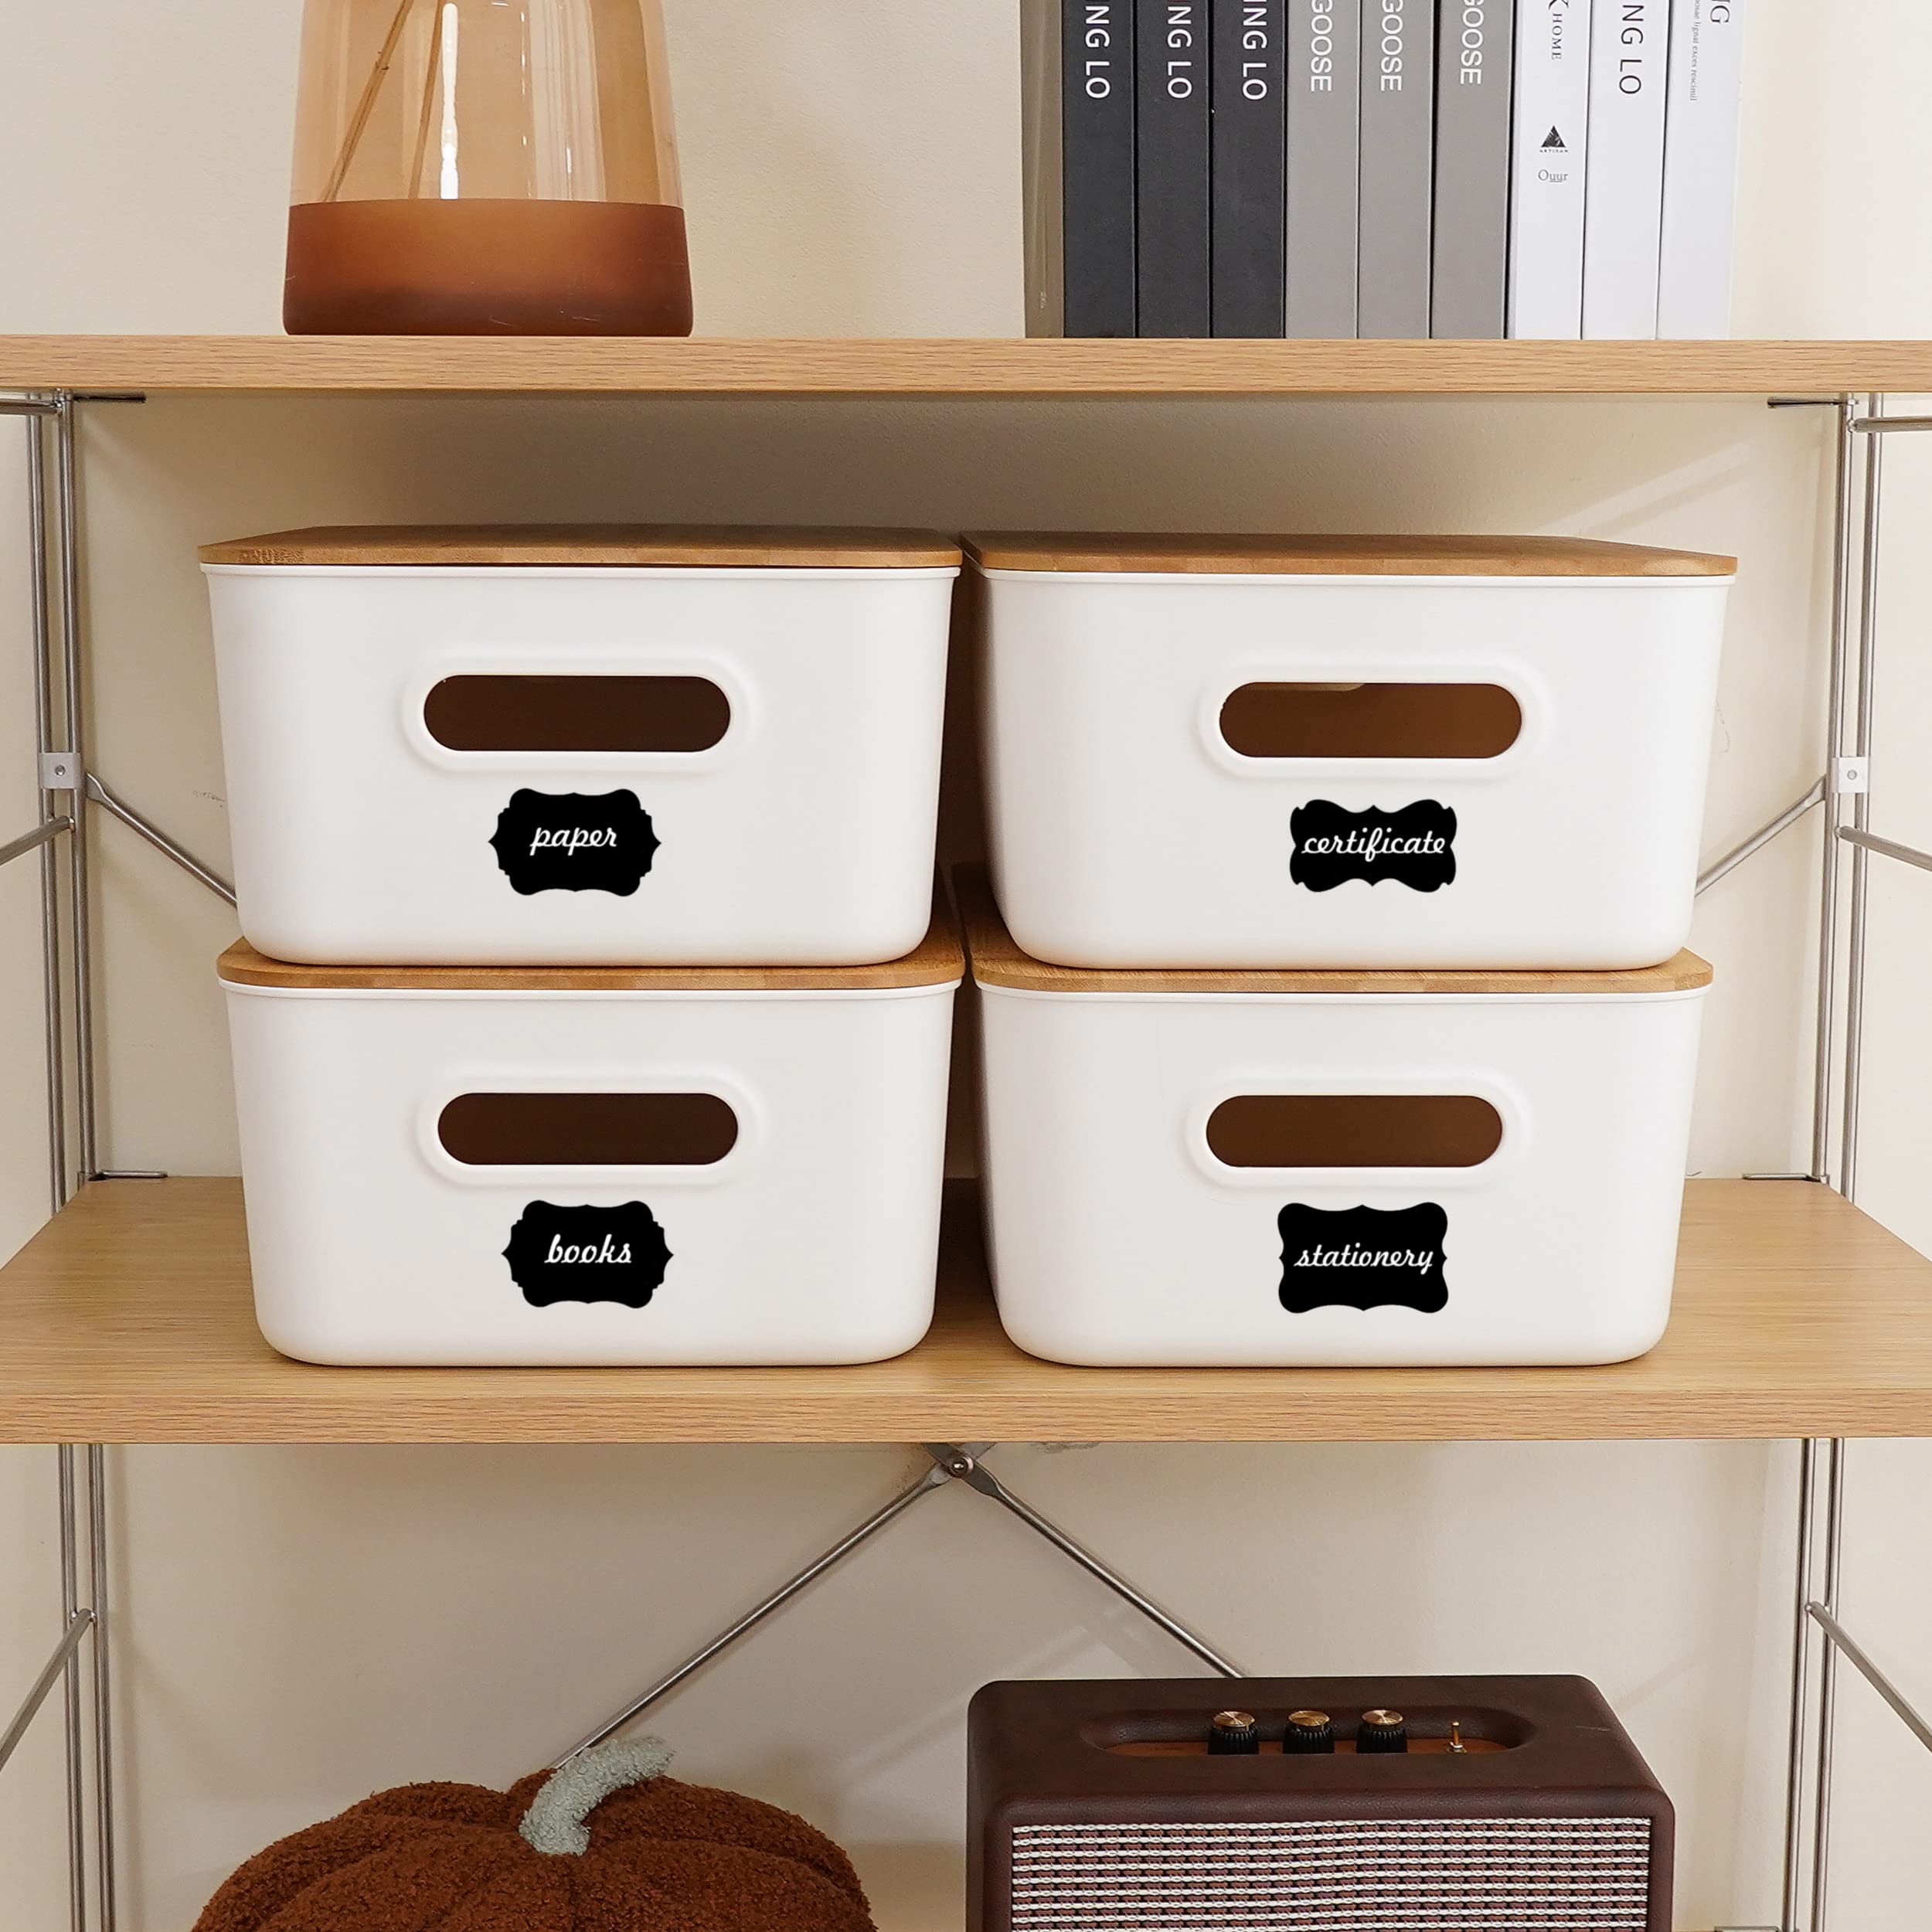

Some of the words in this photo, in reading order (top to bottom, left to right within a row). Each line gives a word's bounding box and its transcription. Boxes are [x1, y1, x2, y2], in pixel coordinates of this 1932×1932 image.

[1551, 13, 1563, 60] HOME
[1621, 5, 1645, 45] NG
[1310, 0, 1333, 92] GOOSE
[1380, 0, 1403, 92] GOOSE
[1084, 60, 1111, 99] LO
[1167, 60, 1192, 99] LO
[1242, 62, 1268, 100] LO
[1619, 59, 1642, 94] LO
[529, 827, 617, 856] paper
[1301, 827, 1446, 862] certificate
[543, 1233, 632, 1264] books
[1293, 1242, 1434, 1275] stationery
